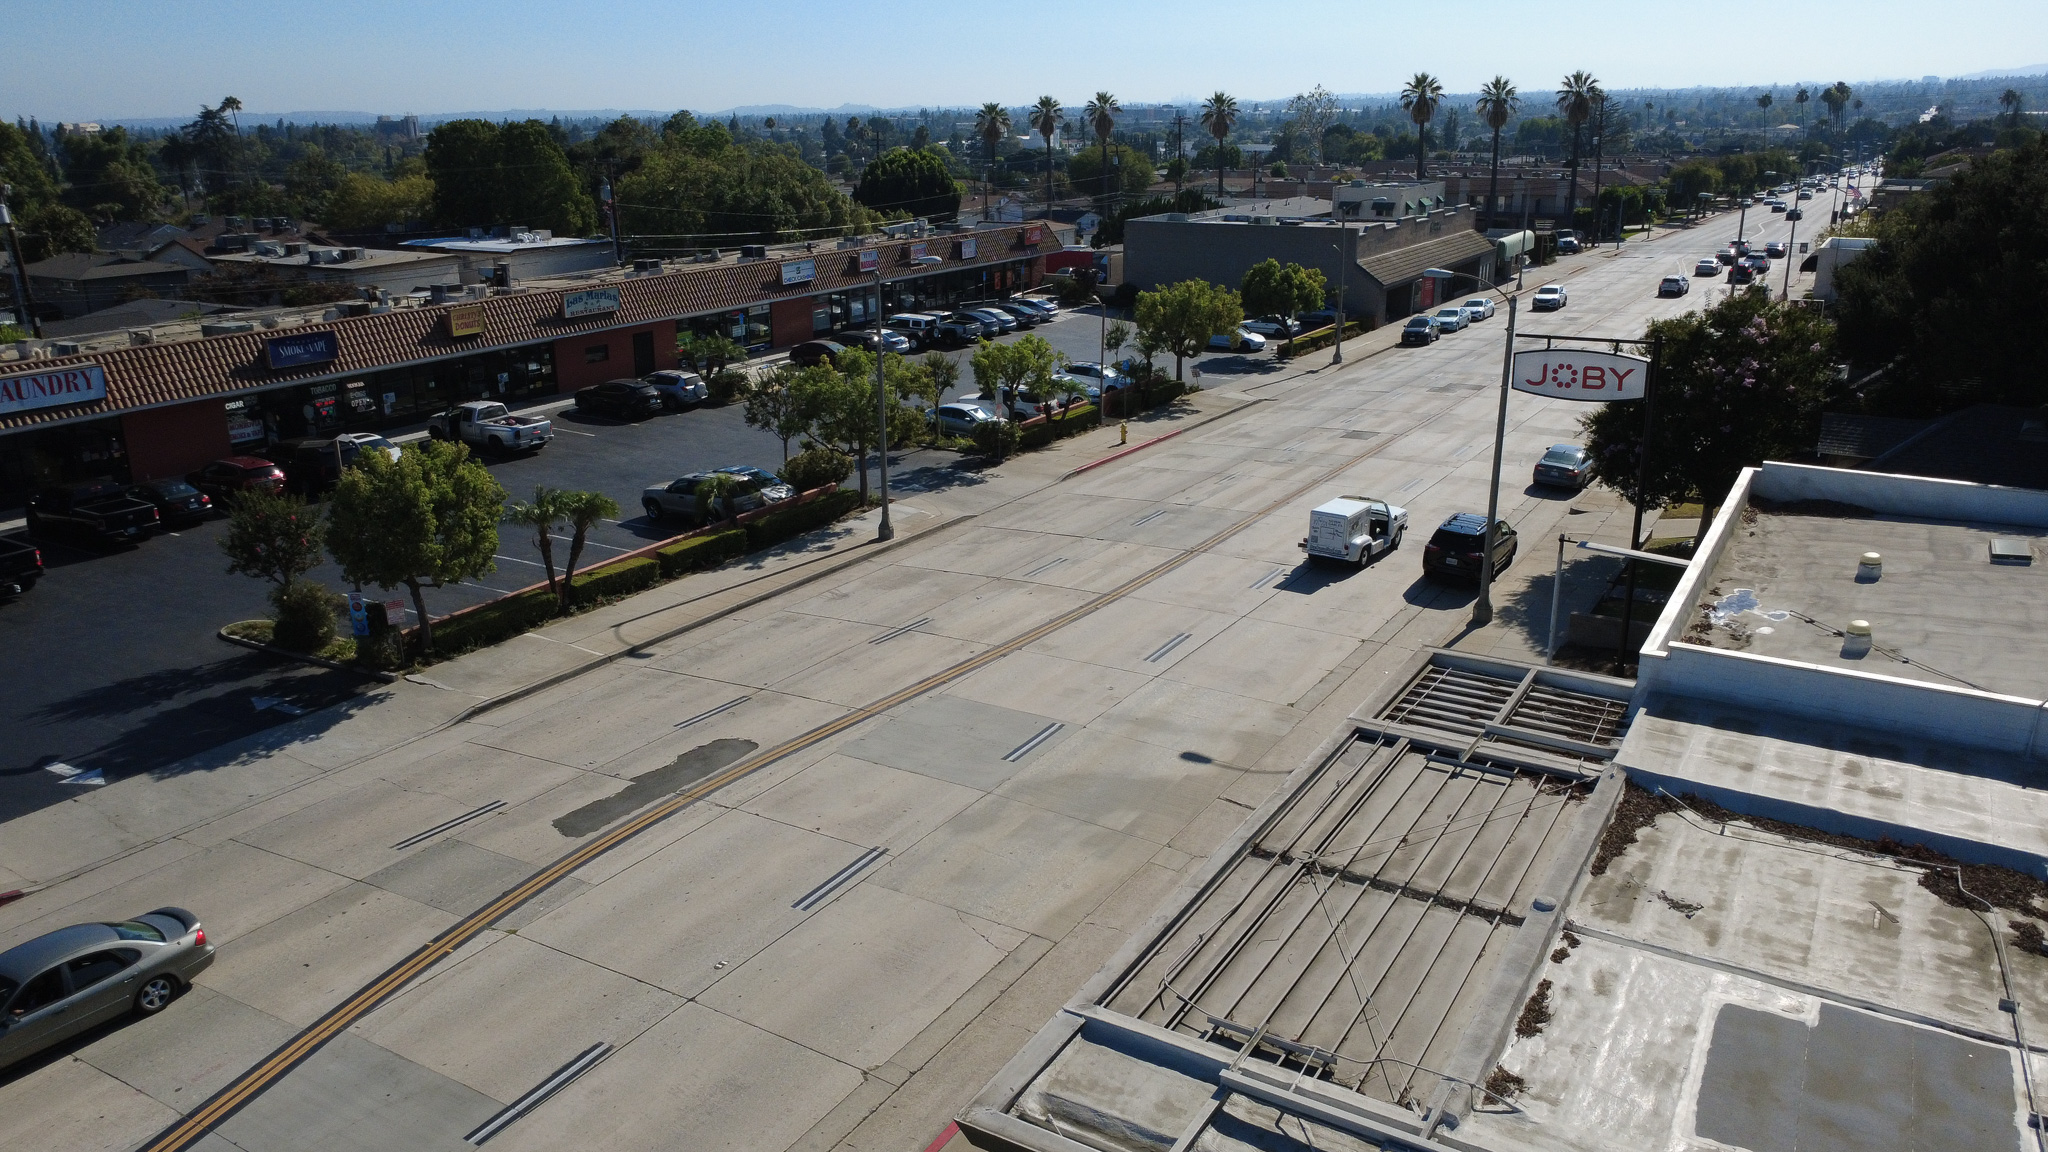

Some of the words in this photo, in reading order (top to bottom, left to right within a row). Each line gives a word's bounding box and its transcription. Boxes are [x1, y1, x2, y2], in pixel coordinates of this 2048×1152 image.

[570, 304, 615, 316] RESTAURANT
[456, 320, 480, 330] DONUTS
[278, 344, 304, 358] SMOKE
[309, 340, 328, 352] VAPE
[1525, 363, 1636, 392] JOBY
[310, 384, 337, 395] TOBACCO
[224, 400, 244, 410] CIGAR
[351, 398, 366, 408] OPEN
